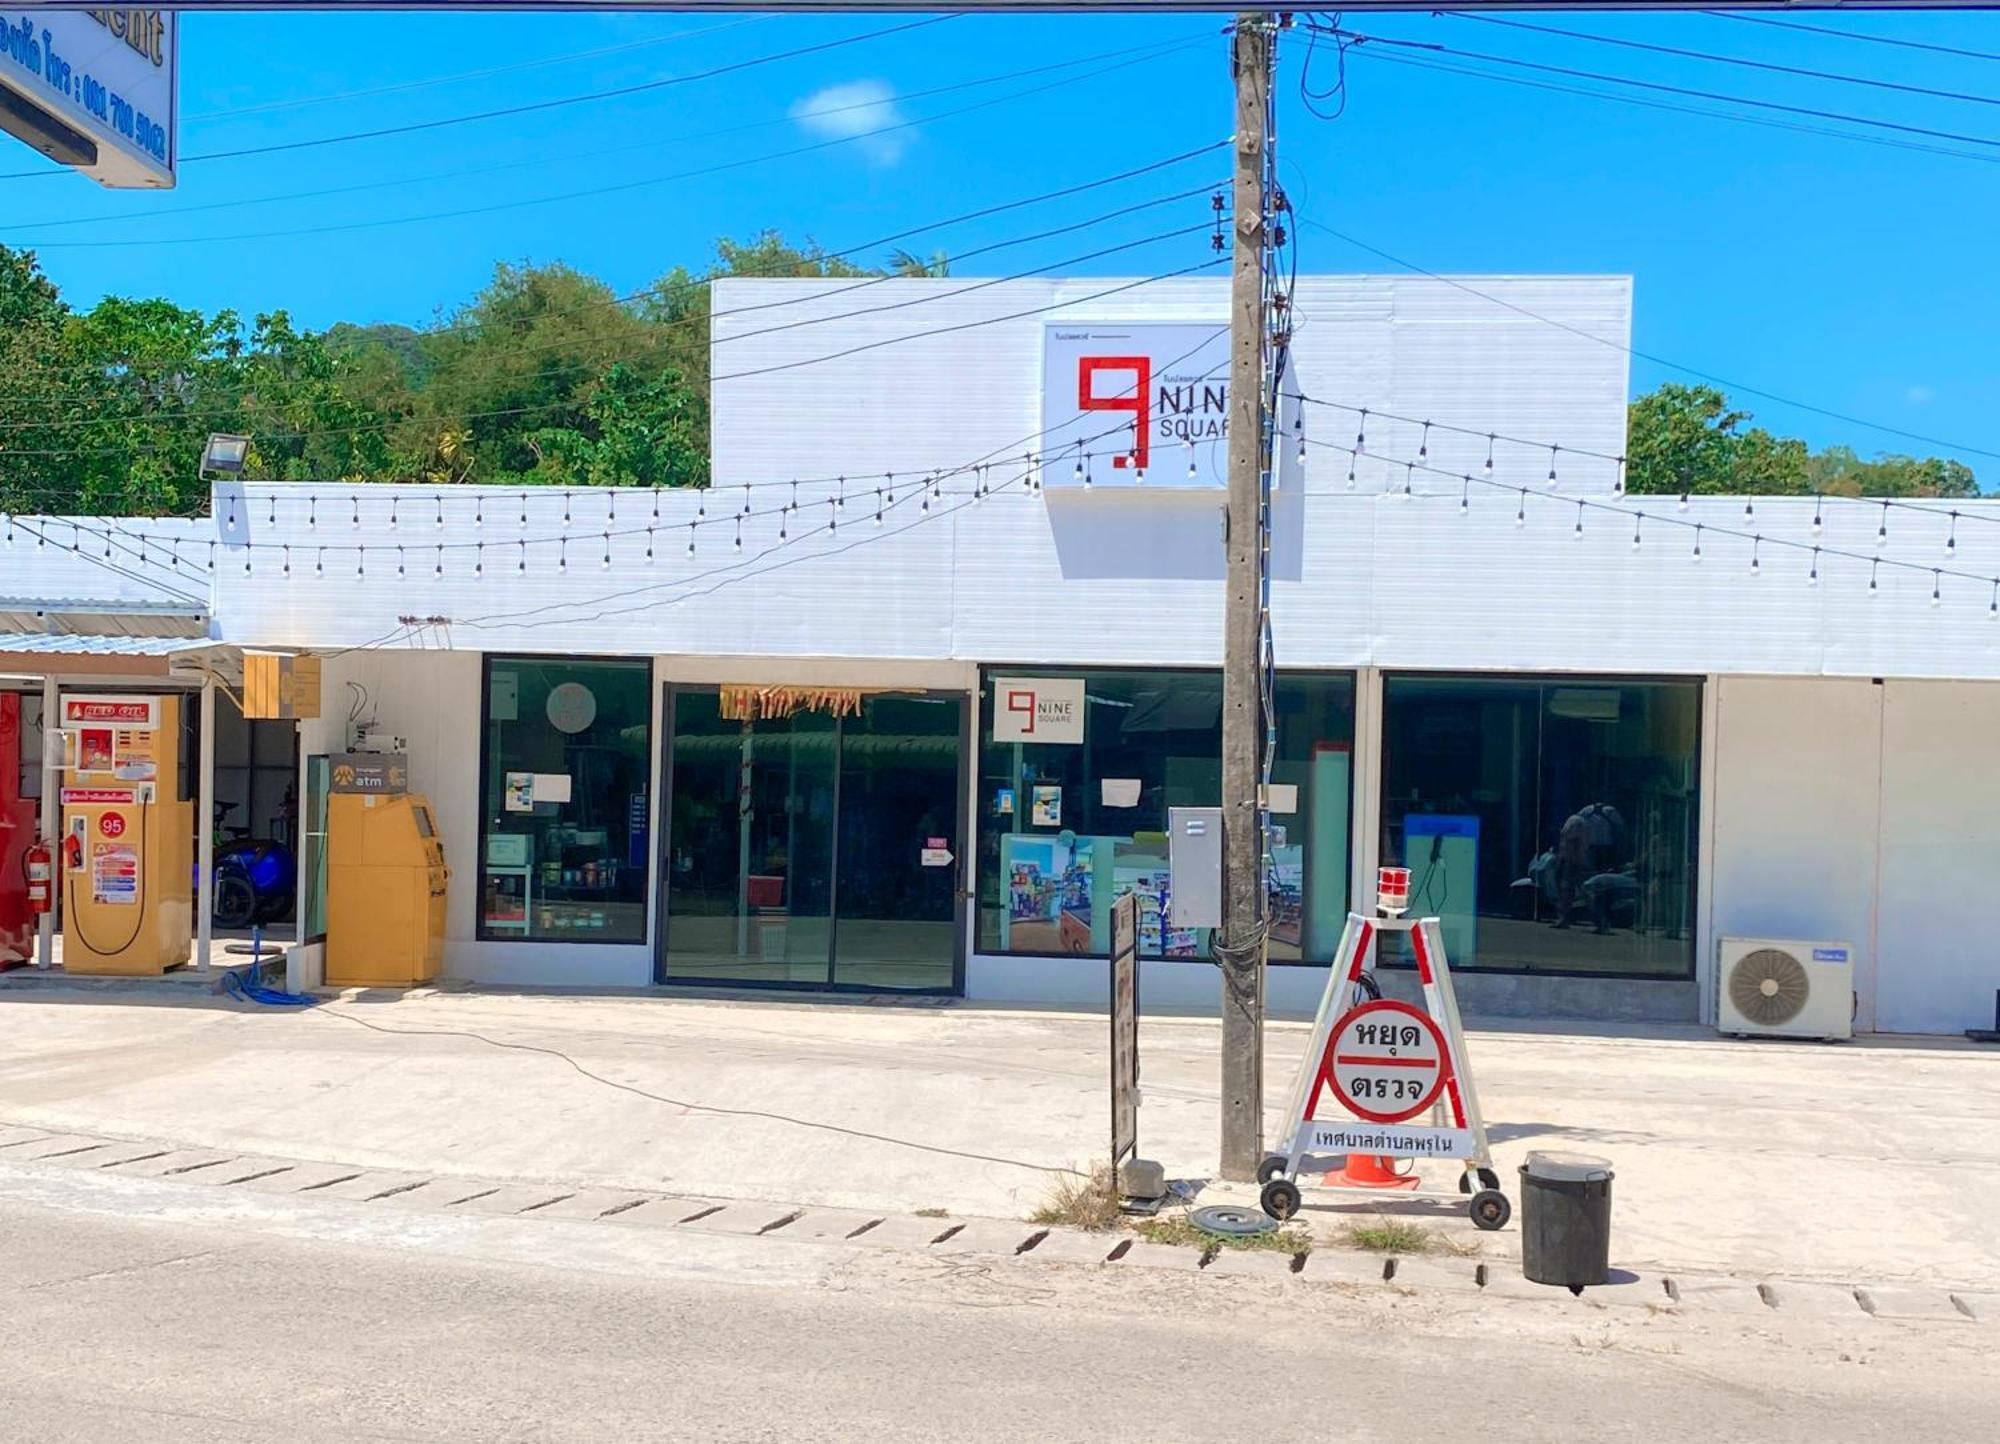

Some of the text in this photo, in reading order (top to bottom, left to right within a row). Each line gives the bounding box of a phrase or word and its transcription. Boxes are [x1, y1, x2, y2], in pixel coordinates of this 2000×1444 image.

[86, 10, 164, 67] ent
[1160, 385, 1225, 414] NIN
[1038, 703, 1073, 714] NINE
[1038, 714, 1072, 723] SQUARE
[356, 776, 382, 787] atm
[103, 819, 122, 833] 95
[1355, 1024, 1421, 1057] หยุด
[1351, 1077, 1424, 1100] ตรวจ
